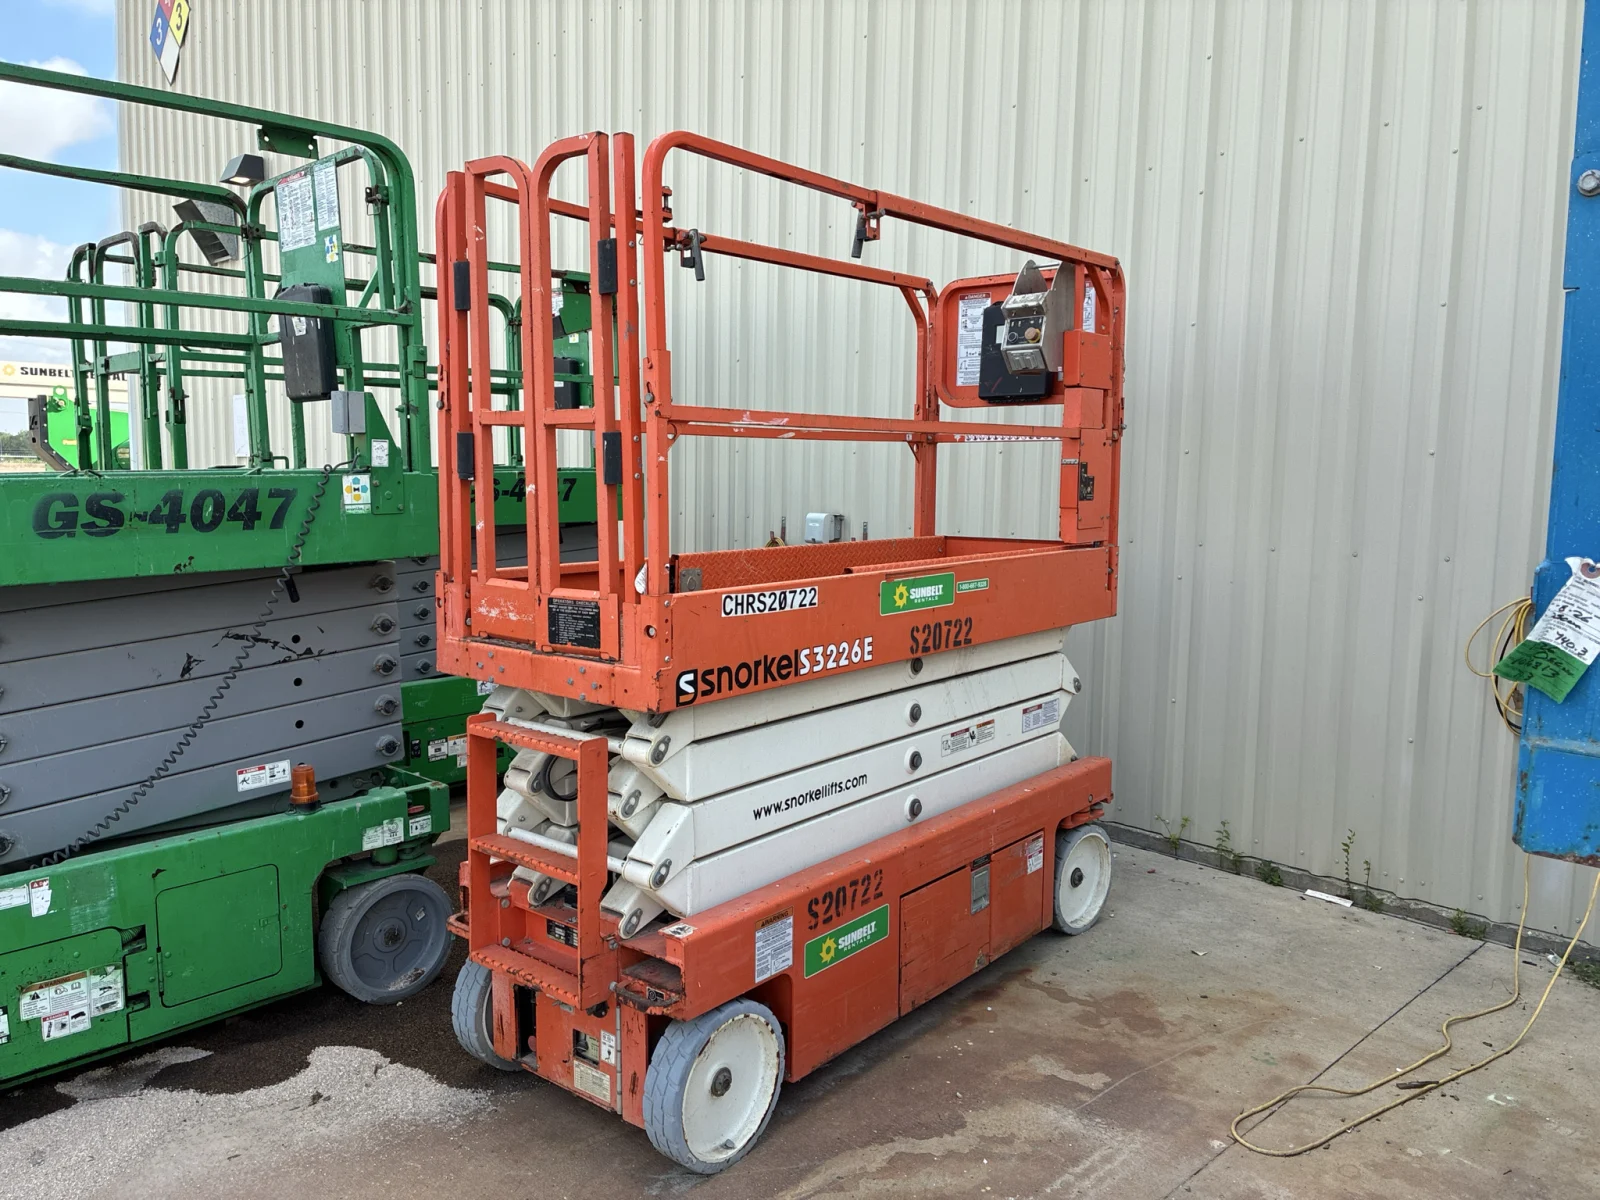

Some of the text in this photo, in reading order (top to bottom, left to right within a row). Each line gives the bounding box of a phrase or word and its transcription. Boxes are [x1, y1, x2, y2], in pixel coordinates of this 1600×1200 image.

[156, 17, 163, 46] 3
[176, 2, 183, 31] 3
[32, 488, 299, 539] GS-4047
[722, 586, 818, 616] CHRS20722
[910, 584, 944, 600] SUNBELT
[909, 616, 972, 654] S20722
[700, 649, 798, 697] snorkel
[800, 636, 873, 676] S3226E
[753, 774, 868, 820] www.snorkellifts.com
[808, 868, 883, 930] S20722
[838, 921, 876, 949] SUNBELT
[844, 934, 871, 952] RENTALS
